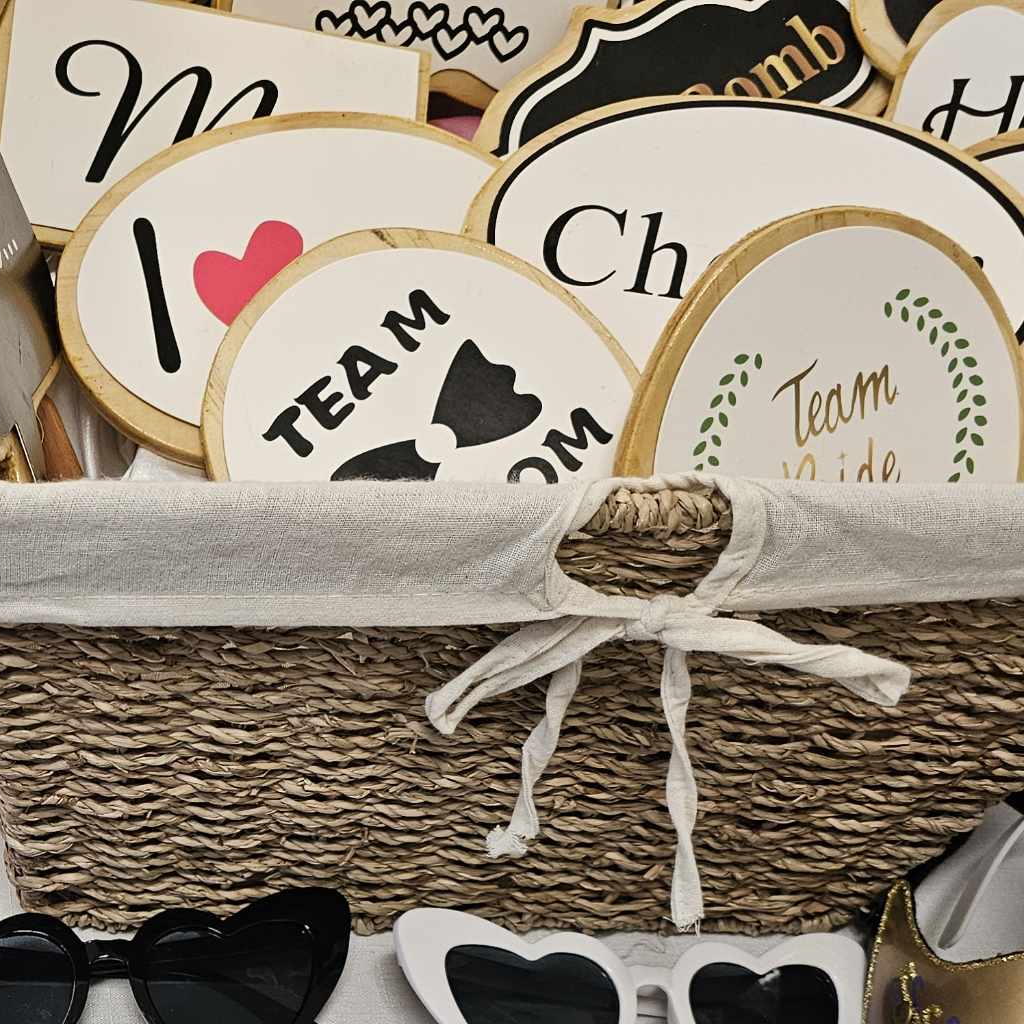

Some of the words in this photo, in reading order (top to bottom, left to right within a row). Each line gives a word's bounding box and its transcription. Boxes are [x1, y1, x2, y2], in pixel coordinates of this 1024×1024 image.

[133, 217, 181, 373] I
[261, 288, 451, 458] TEAM
[771, 358, 900, 448] Team
